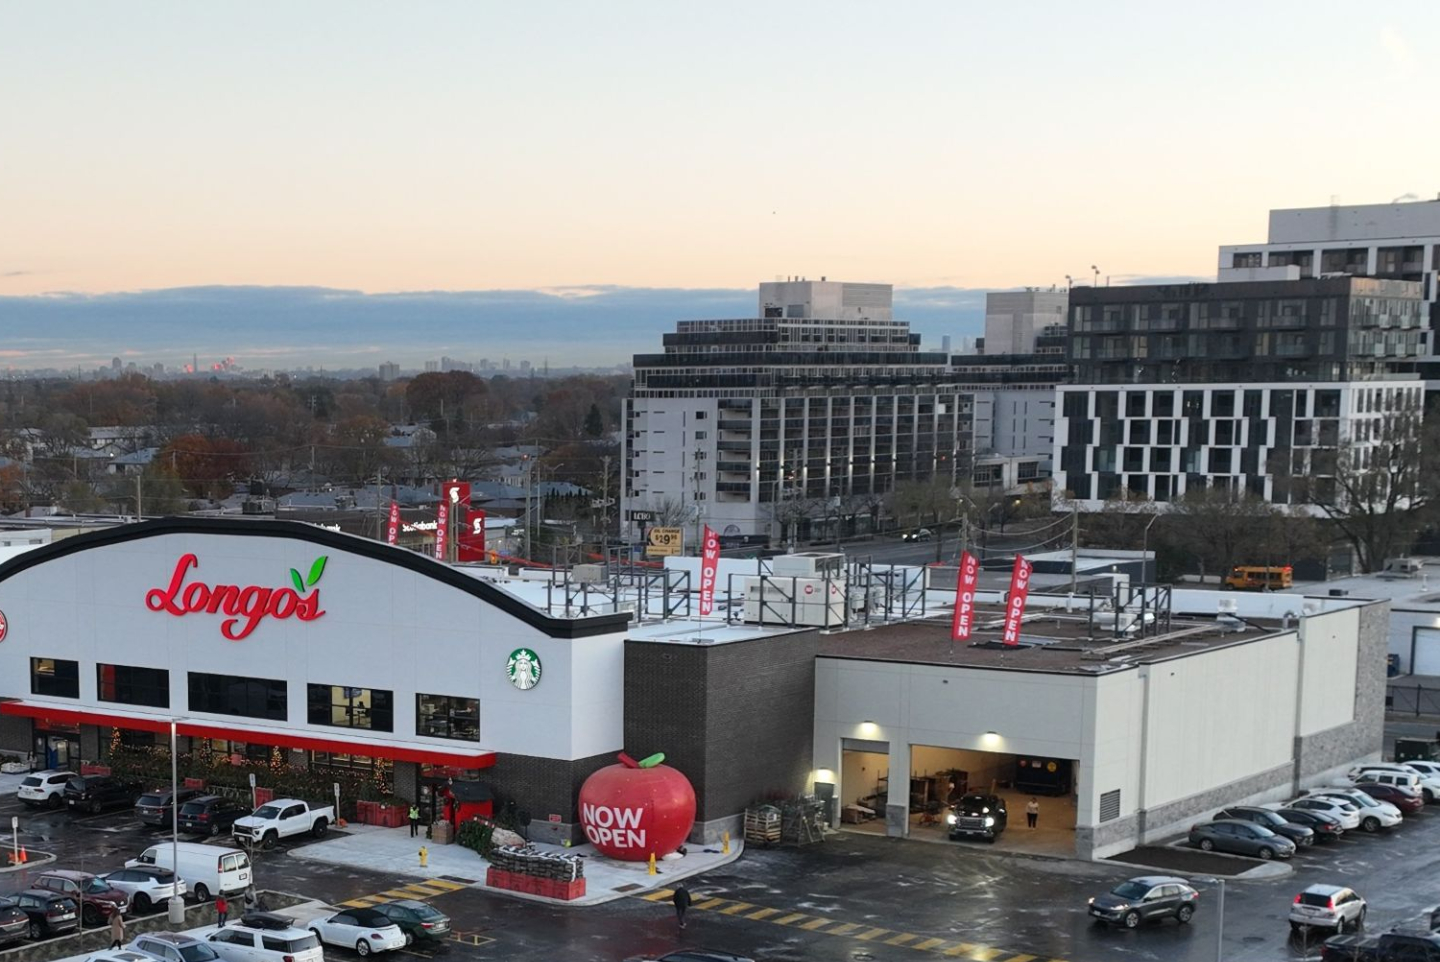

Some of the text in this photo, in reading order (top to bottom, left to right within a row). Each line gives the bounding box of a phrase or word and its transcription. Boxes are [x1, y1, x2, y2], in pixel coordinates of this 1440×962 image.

[388, 527, 398, 545] OP
[434, 505, 447, 559] NOW OPEN
[702, 567, 715, 612] OPEN
[958, 555, 976, 637] NOW OPEN
[1005, 560, 1028, 642] NOW OPEN
[583, 803, 643, 829] NOW
[586, 825, 645, 848] OPEN
